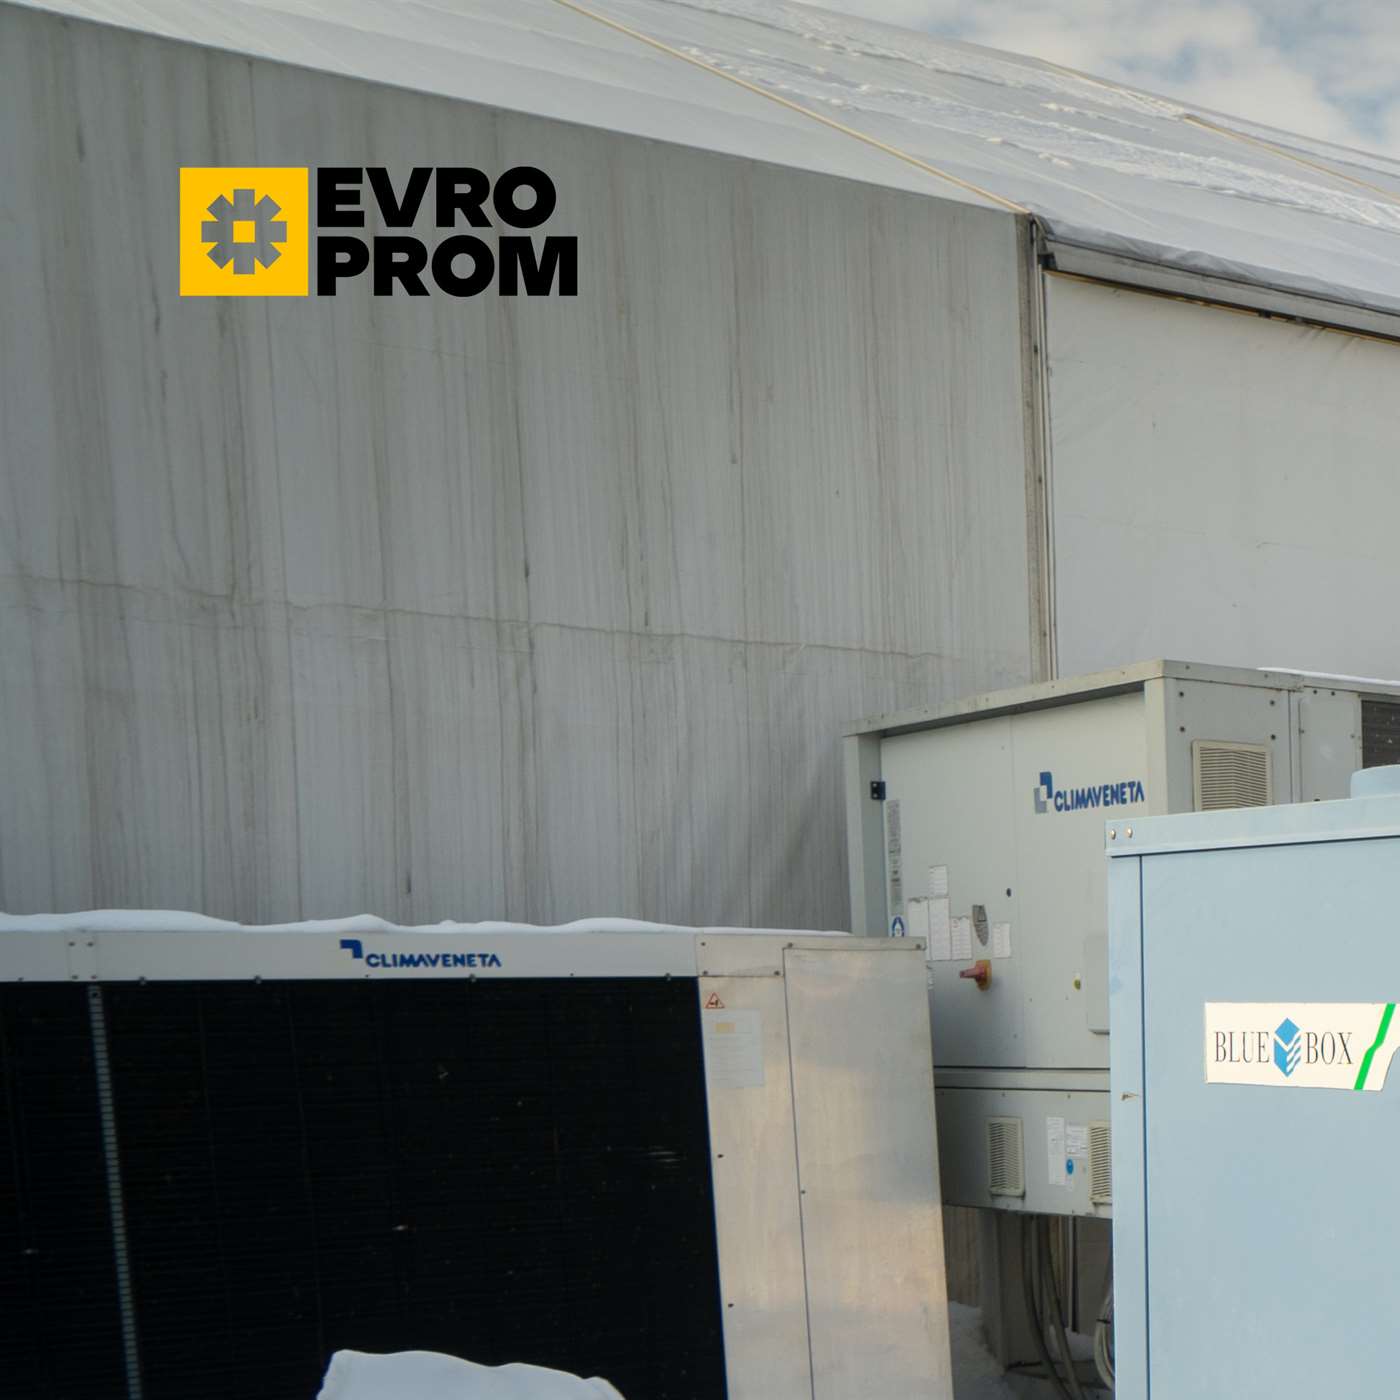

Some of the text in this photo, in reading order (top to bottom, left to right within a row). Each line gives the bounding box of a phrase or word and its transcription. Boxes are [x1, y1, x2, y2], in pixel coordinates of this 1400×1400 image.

[1054, 781, 1145, 812] CLIMAVENETA
[365, 953, 502, 968] CLIMAVENETA
[1215, 1031, 1354, 1065] BLUE BOX
